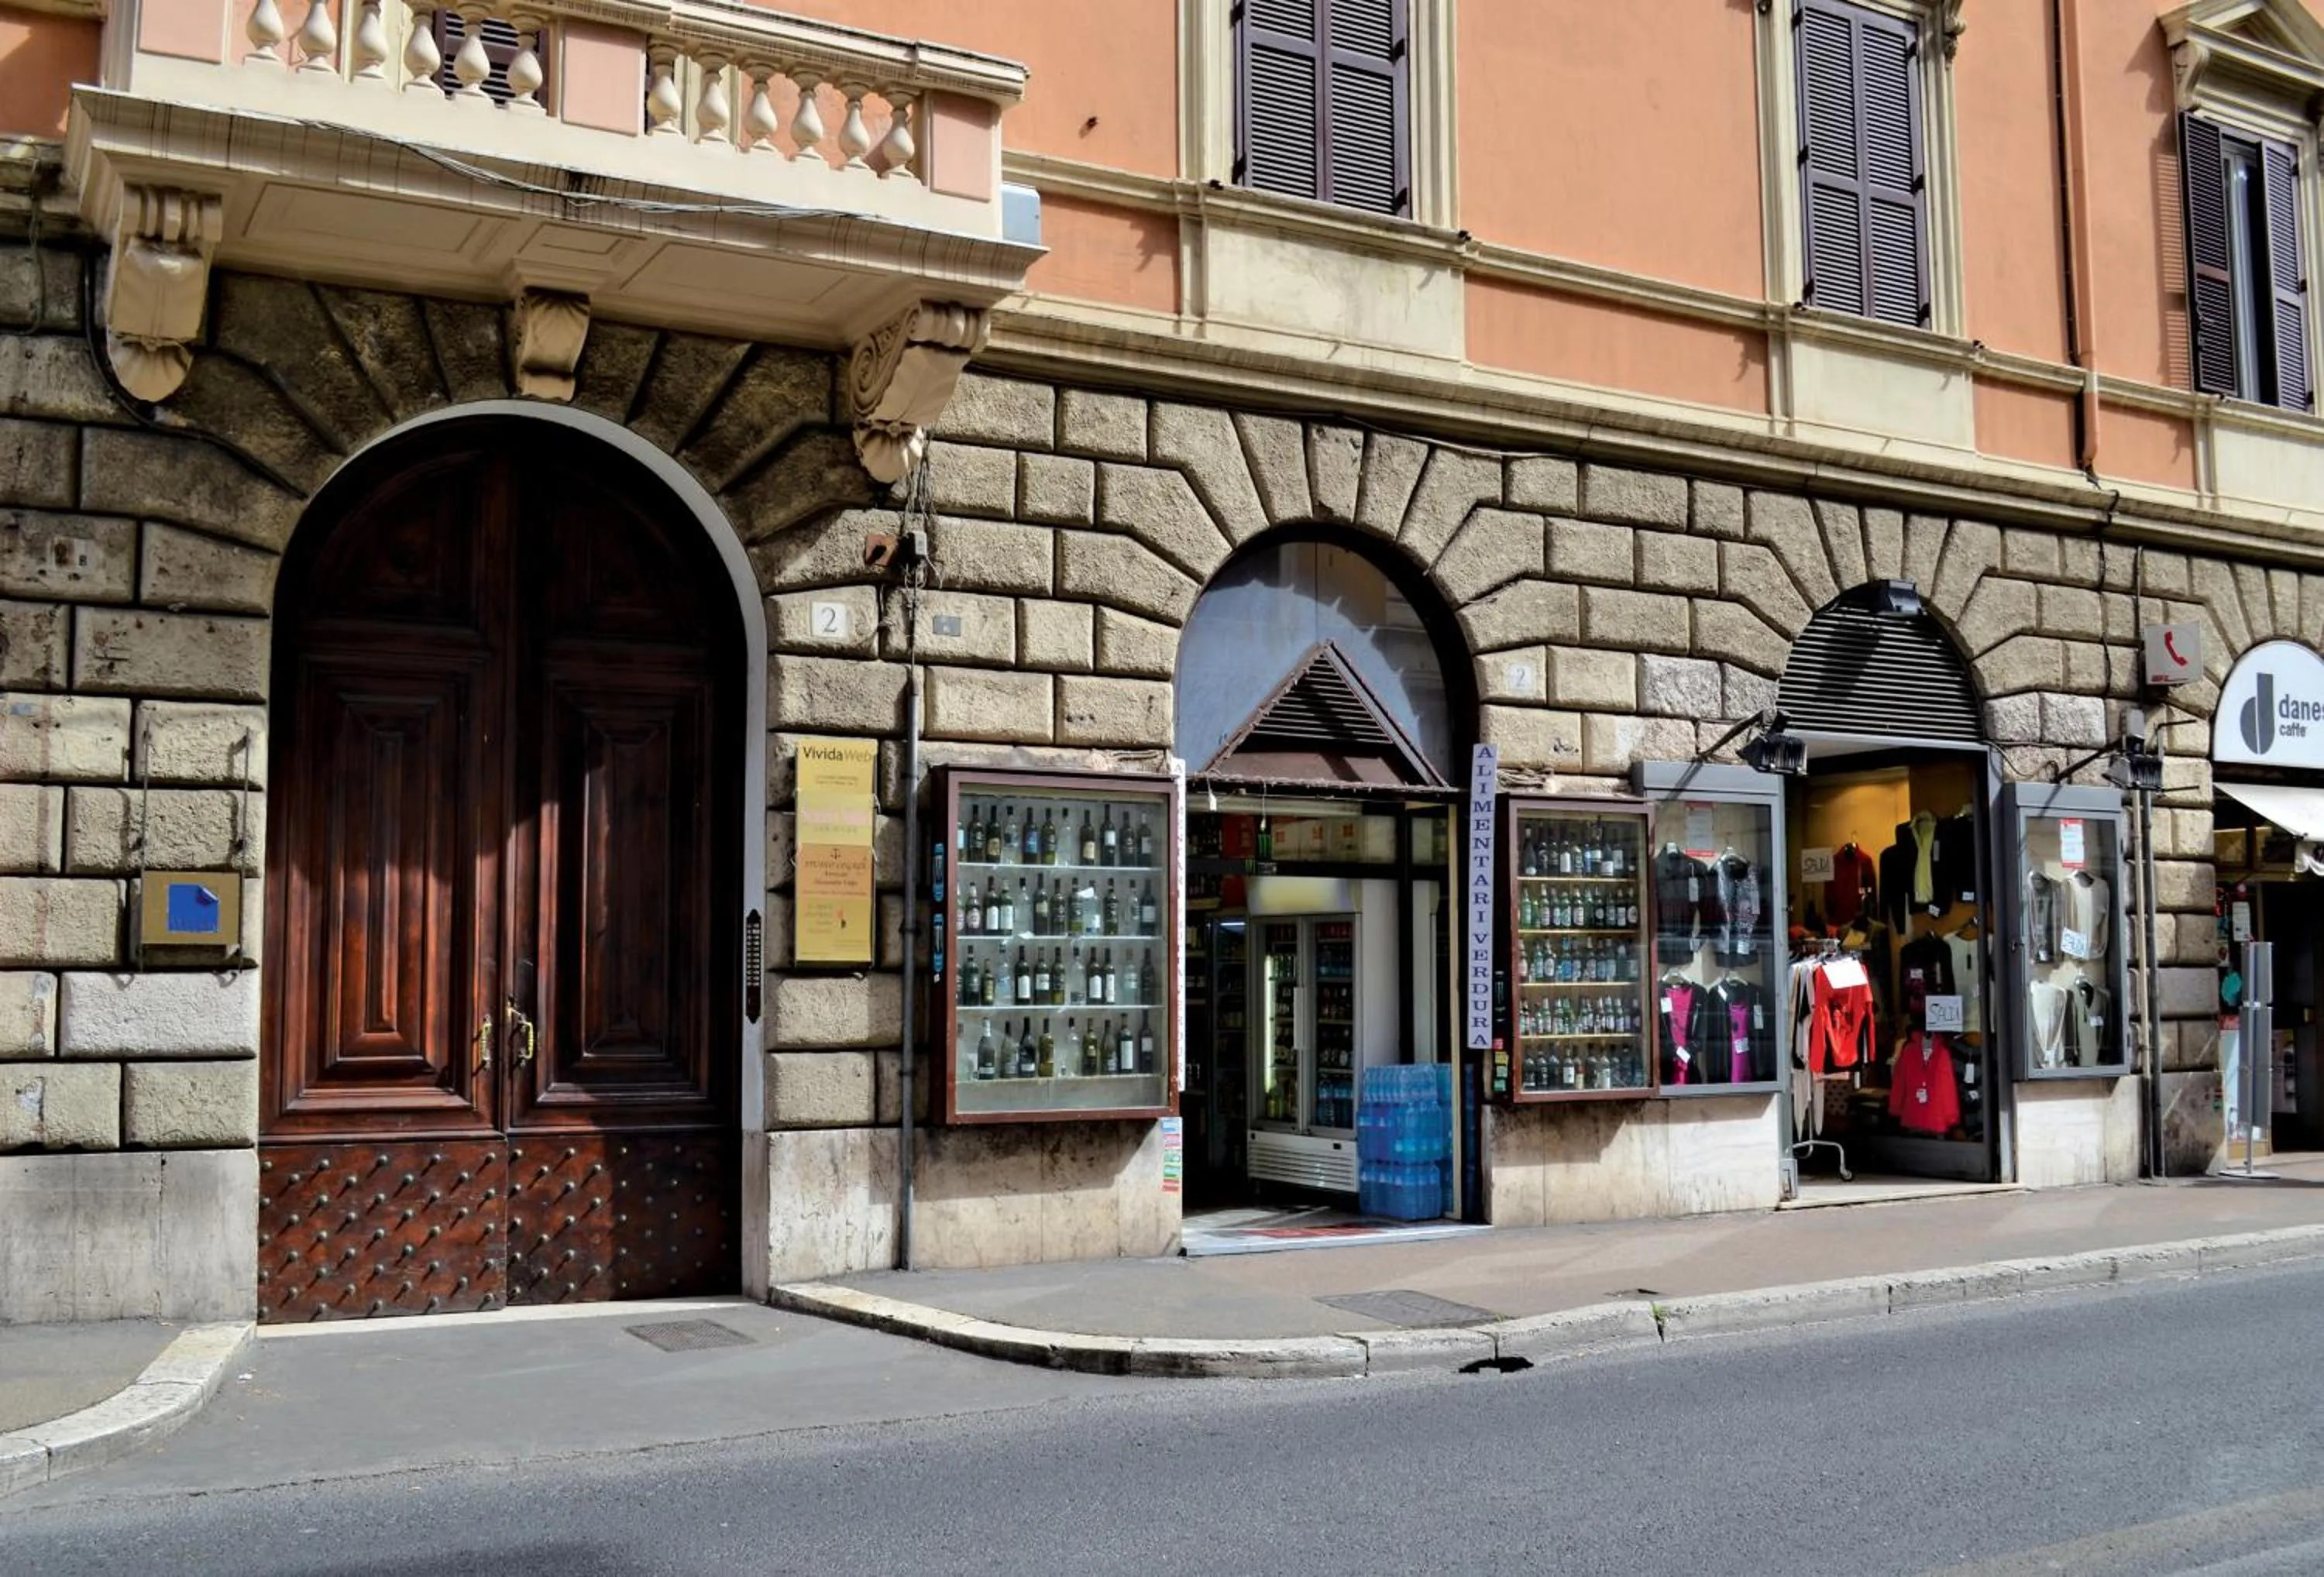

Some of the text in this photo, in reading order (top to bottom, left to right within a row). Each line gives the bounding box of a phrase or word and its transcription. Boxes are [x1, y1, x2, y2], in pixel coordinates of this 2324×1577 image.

[821, 606, 837, 634] 2
[2279, 693, 2324, 721] dane
[803, 745, 871, 763] VividaWeb
[1472, 746, 1494, 1046] ALIMENTARI VERDURA
